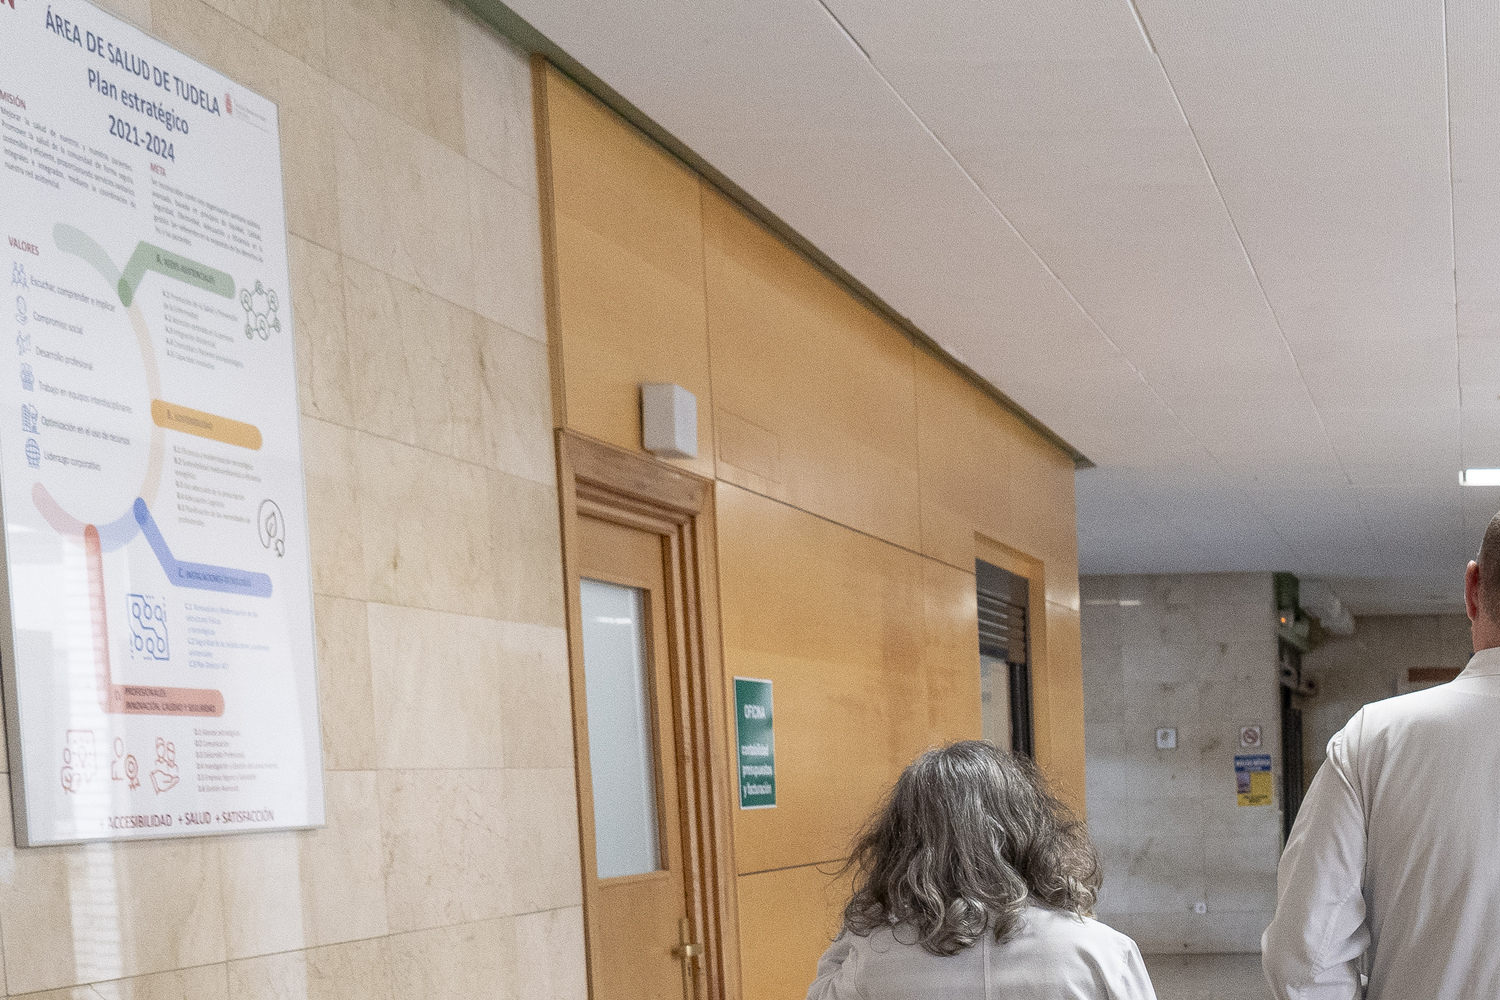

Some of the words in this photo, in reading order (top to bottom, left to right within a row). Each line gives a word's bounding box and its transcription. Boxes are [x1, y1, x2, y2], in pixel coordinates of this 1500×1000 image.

[46, 5, 82, 48] ÁREA
[86, 30, 105, 58] DE
[107, 42, 150, 81] SALUD
[153, 66, 171, 92] DE
[173, 76, 221, 117] TUDELA
[87, 68, 118, 101] Plan
[121, 88, 189, 135] estratégico
[108, 115, 176, 163] 2021-2024
[8, 234, 39, 256] VALORES
[107, 813, 172, 830] ACCESIBILIDAD
[184, 811, 212, 826] SALUD
[222, 807, 275, 824] SATISFACCIÓN
